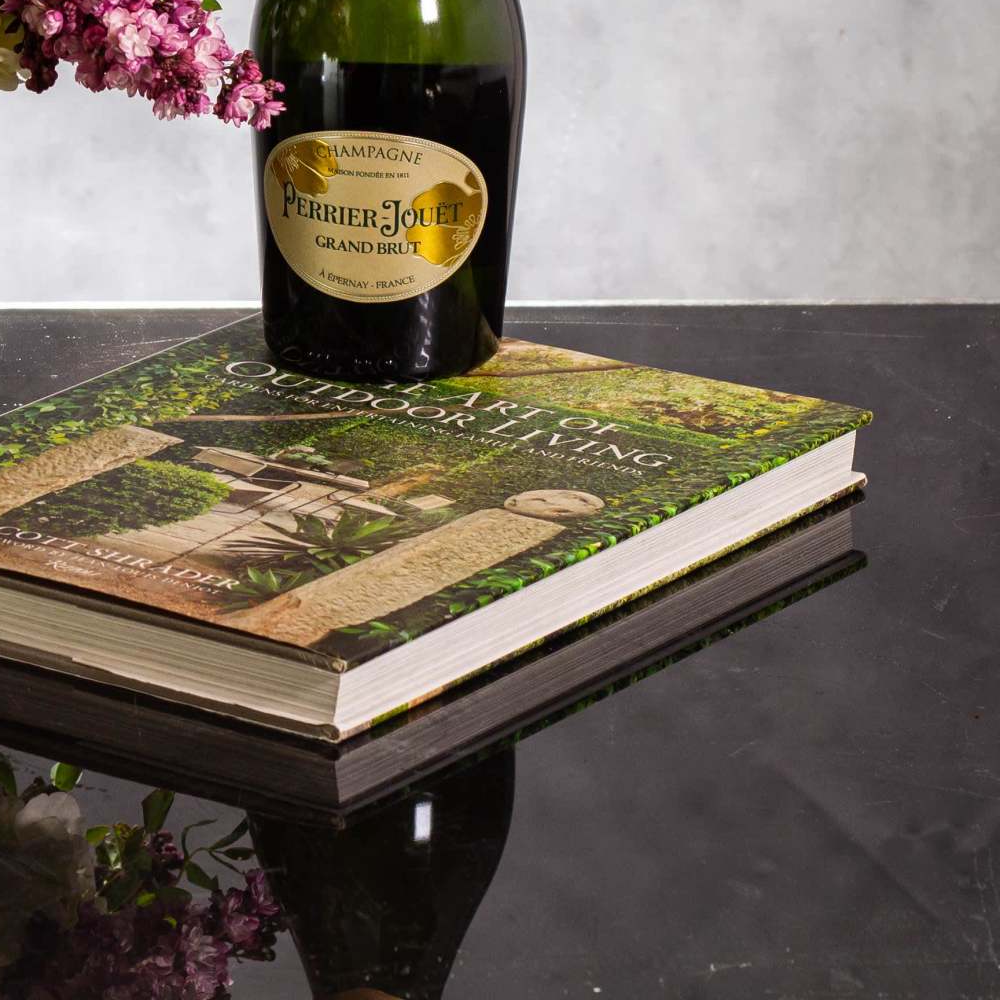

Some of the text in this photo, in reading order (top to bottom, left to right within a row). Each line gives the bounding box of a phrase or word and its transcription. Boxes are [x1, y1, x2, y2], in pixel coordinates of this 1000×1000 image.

[316, 144, 423, 166] CHAMPAGNE
[315, 235, 422, 255] GRAND BRUT
[376, 274, 416, 289] FRANCE
[203, 373, 285, 397] GARDENS
[523, 447, 566, 460] AND
[566, 455, 646, 477] FRIENDS
[225, 360, 674, 468] OUTDOOR LIVING
[436, 391, 630, 435] ART OF
[85, 547, 241, 591] SHRADER
